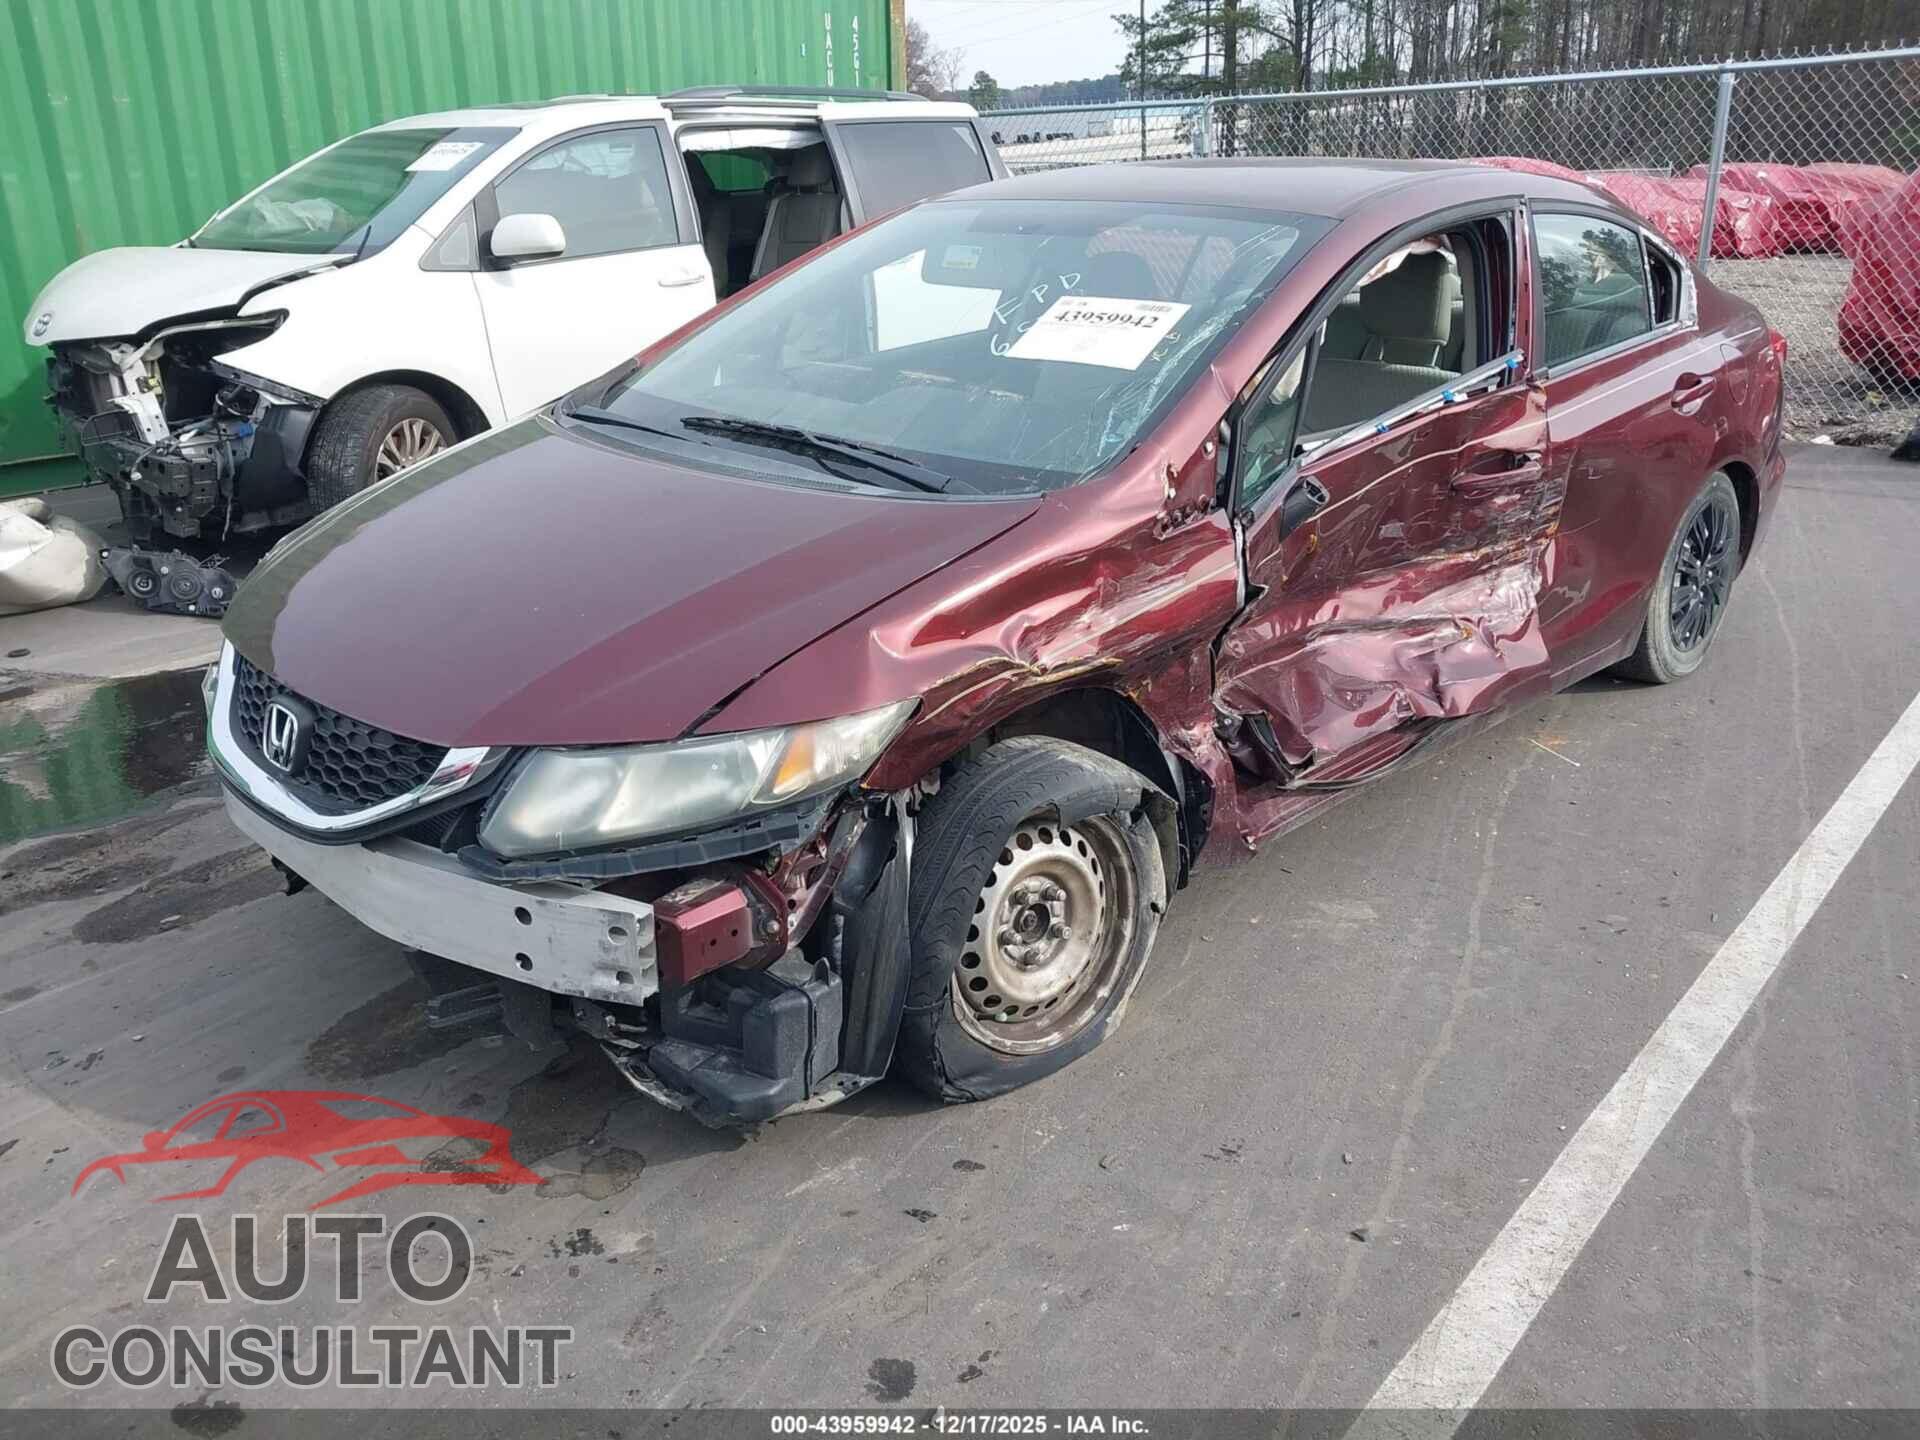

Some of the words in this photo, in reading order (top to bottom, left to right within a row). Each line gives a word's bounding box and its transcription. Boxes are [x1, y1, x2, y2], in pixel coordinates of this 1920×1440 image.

[824, 11, 834, 88] UACU
[851, 15, 860, 89] 45G1
[1054, 309, 1160, 329] 43959942
